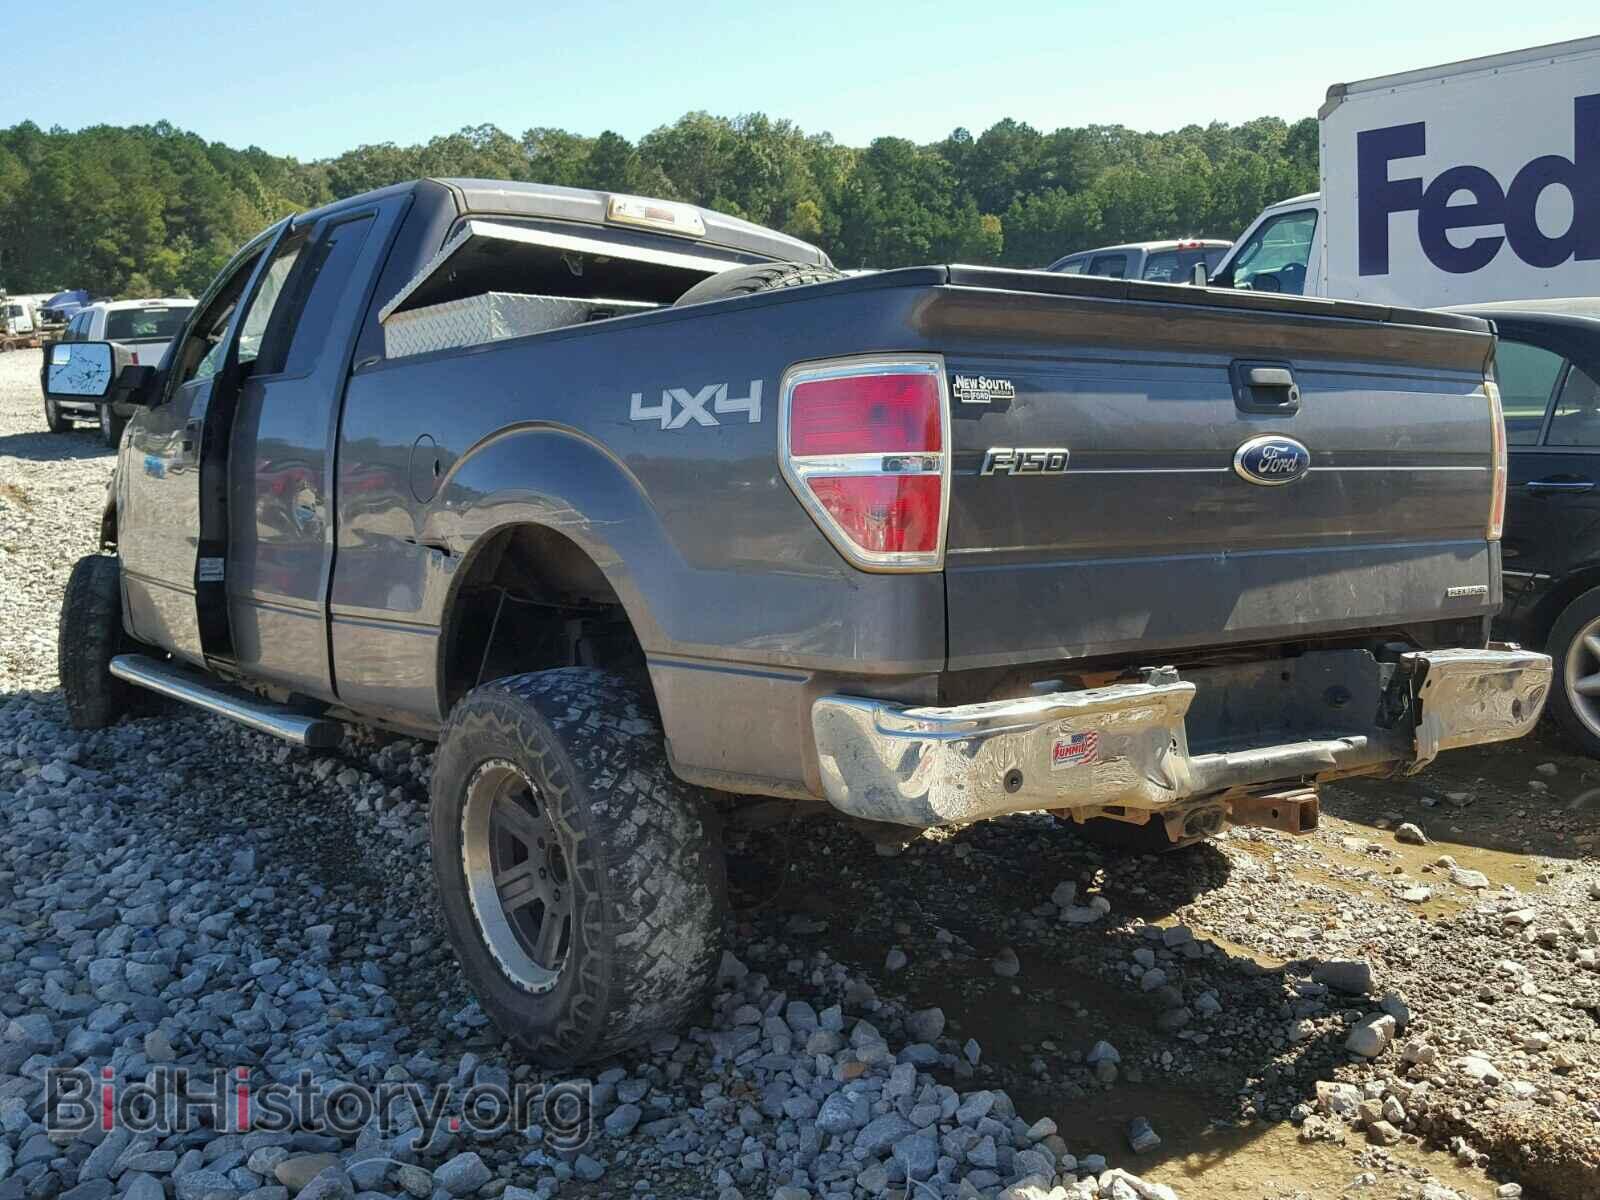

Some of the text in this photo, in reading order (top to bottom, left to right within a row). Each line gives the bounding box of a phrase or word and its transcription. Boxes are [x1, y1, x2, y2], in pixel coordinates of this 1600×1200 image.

[1357, 94, 1600, 276] Fed
[955, 375, 1011, 390] NEW SOUTH
[1257, 446, 1298, 473] Ford
